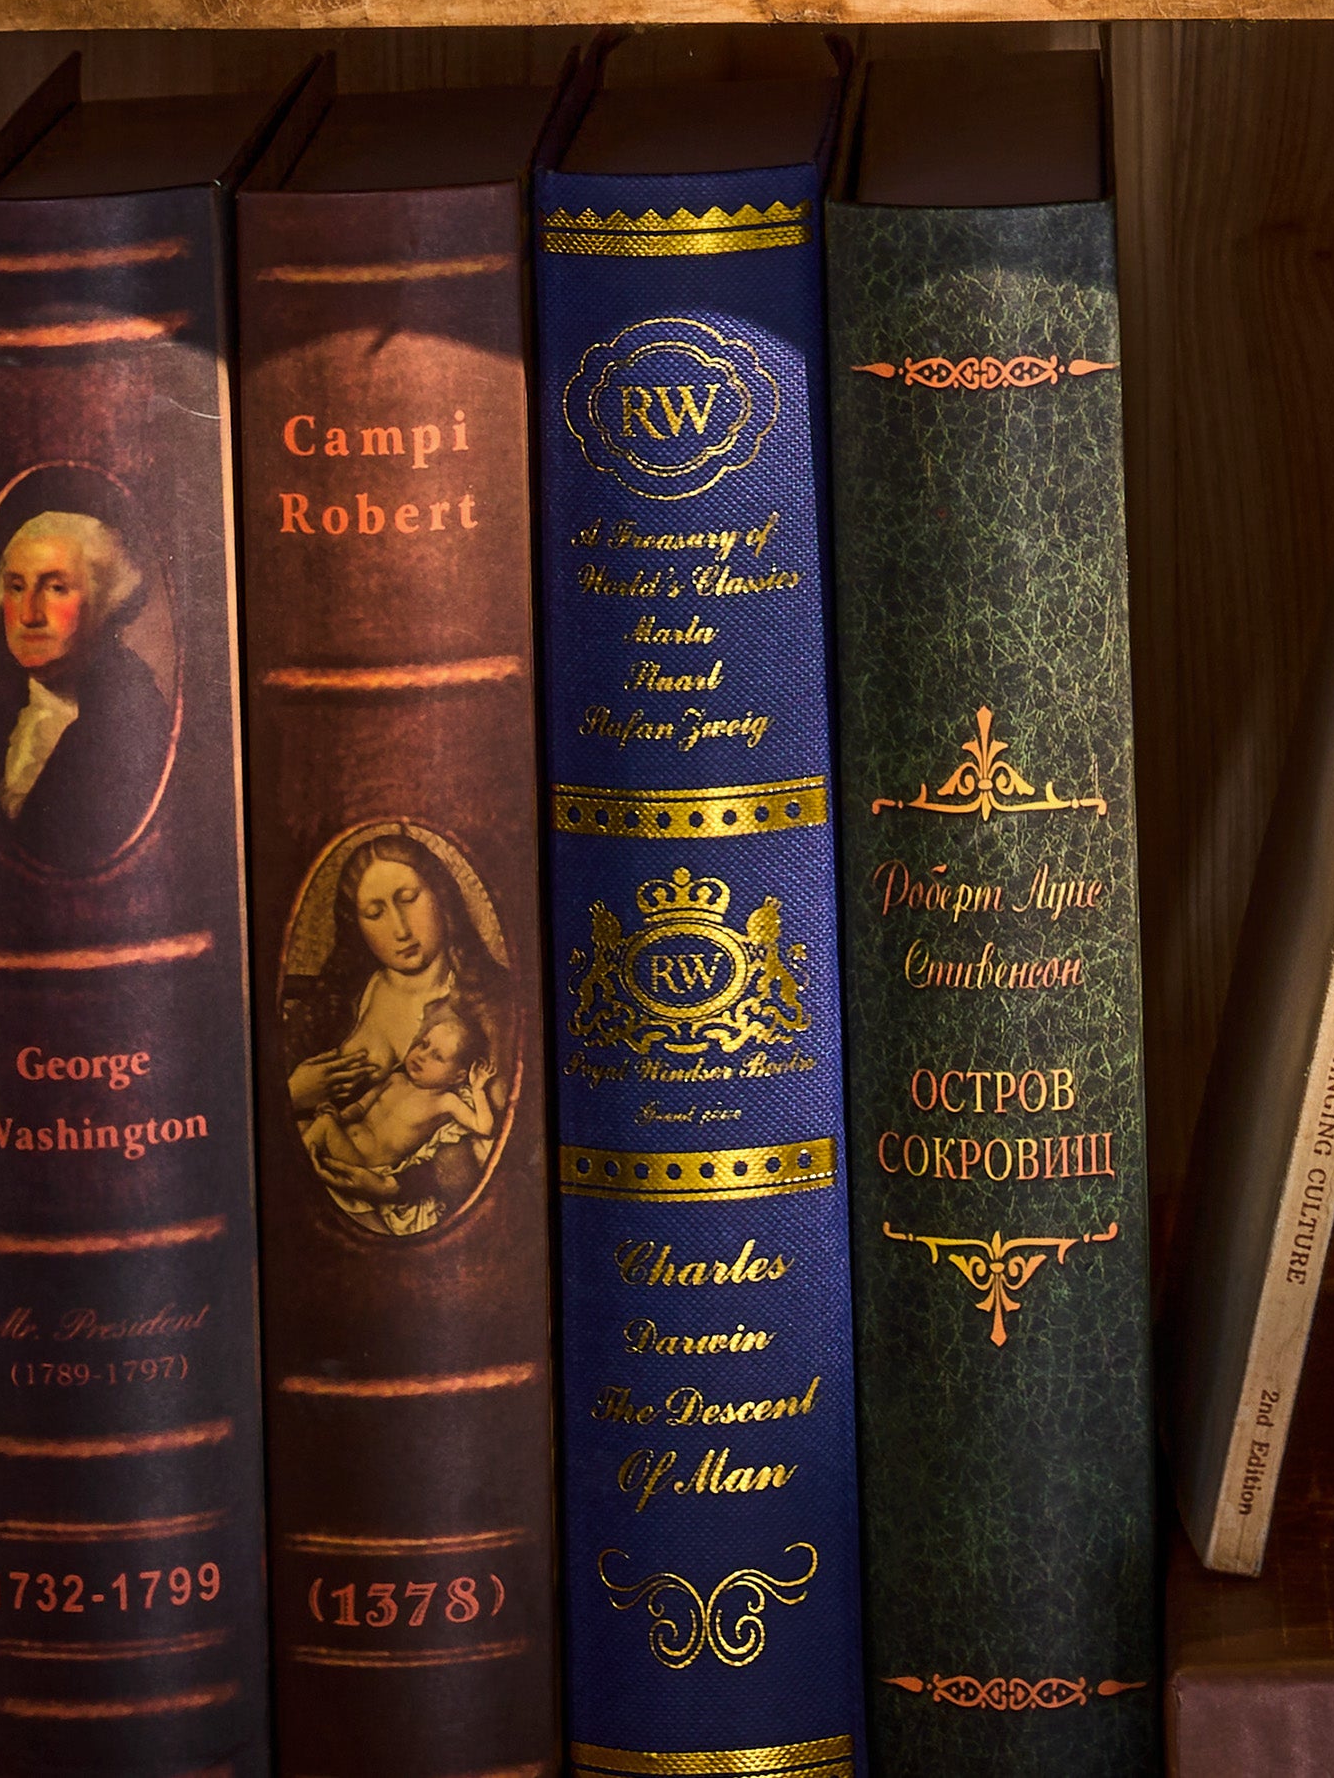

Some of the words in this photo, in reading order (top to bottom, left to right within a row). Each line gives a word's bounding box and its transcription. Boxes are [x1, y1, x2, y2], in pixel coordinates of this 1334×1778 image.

[616, 382, 722, 442] RW
[282, 408, 471, 471] Campi
[278, 491, 479, 536] Robert
[744, 509, 782, 559] of
[648, 951, 725, 995] RW
[16, 1046, 152, 1092] George
[910, 1067, 1077, 1115] ОСТРОВ
[876, 1130, 1117, 1183] СОКРОВИЩ
[1283, 1165, 1330, 1287] CULTURE
[612, 1237, 797, 1287] Charles
[53, 1302, 211, 1343] President
[621, 1316, 779, 1357] Darwin
[9, 1353, 189, 1387] (1789-1797)
[589, 1384, 664, 1427] The
[663, 1374, 825, 1429] Descent
[1253, 1388, 1282, 1430] 2nd
[616, 1446, 679, 1515] Of
[673, 1445, 800, 1496] Man
[1237, 1438, 1272, 1517] Edition
[307, 1573, 507, 1629] (1378)
